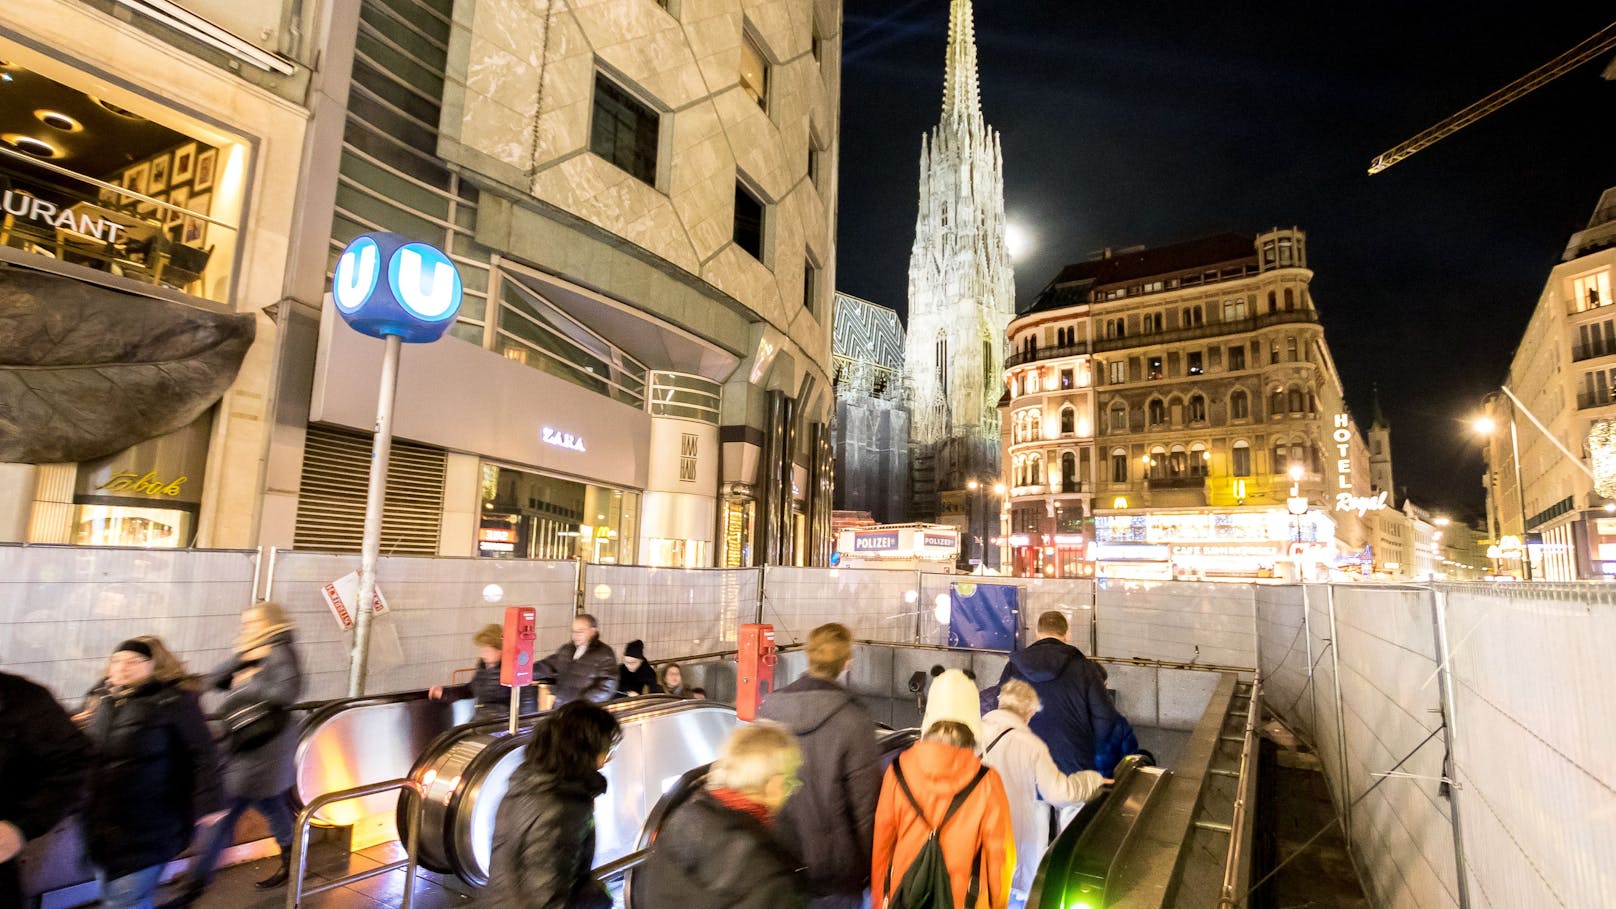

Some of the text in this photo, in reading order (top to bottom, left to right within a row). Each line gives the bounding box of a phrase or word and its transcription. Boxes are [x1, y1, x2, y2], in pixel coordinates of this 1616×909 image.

[0, 190, 126, 243] URANT
[338, 245, 376, 308] U
[398, 248, 455, 317] U
[542, 427, 587, 452] ZARA
[681, 435, 698, 457] HAAS
[1333, 413, 1352, 489] HOTEL
[680, 458, 697, 480] HAUS
[1335, 491, 1389, 518] Royal
[856, 537, 891, 549] POLIZEI
[924, 537, 951, 546] POLIZEI
